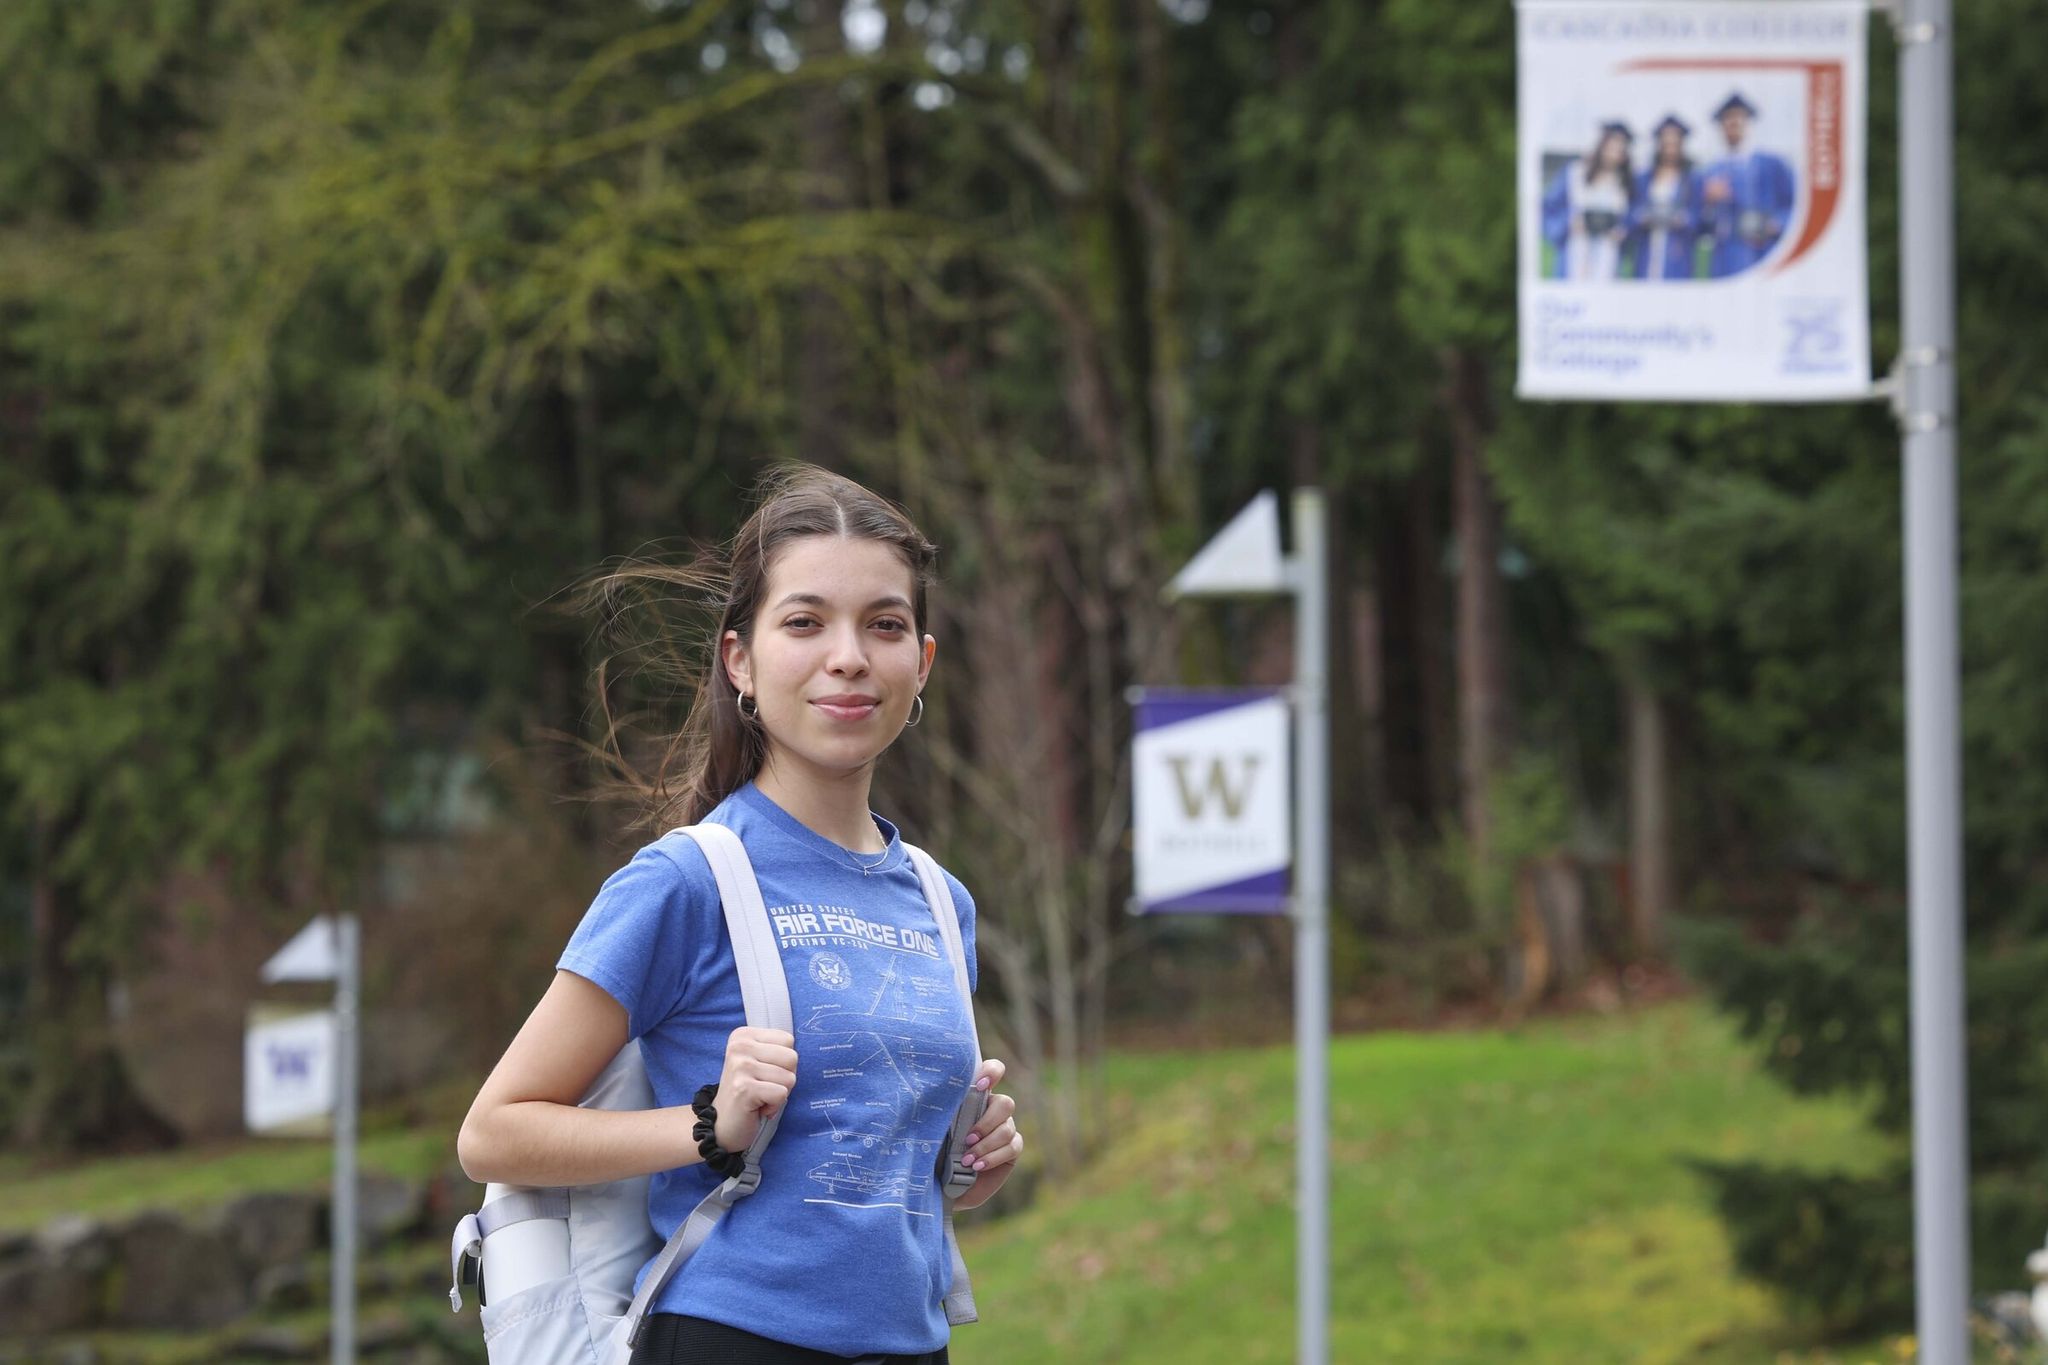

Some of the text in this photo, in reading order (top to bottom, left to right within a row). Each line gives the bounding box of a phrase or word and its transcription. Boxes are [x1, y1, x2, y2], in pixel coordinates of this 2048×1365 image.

[1164, 752, 1261, 822] W
[770, 904, 856, 917] UNITED STATES
[774, 913, 940, 957] AIR FORCE ONE
[782, 937, 827, 948] BOEING
